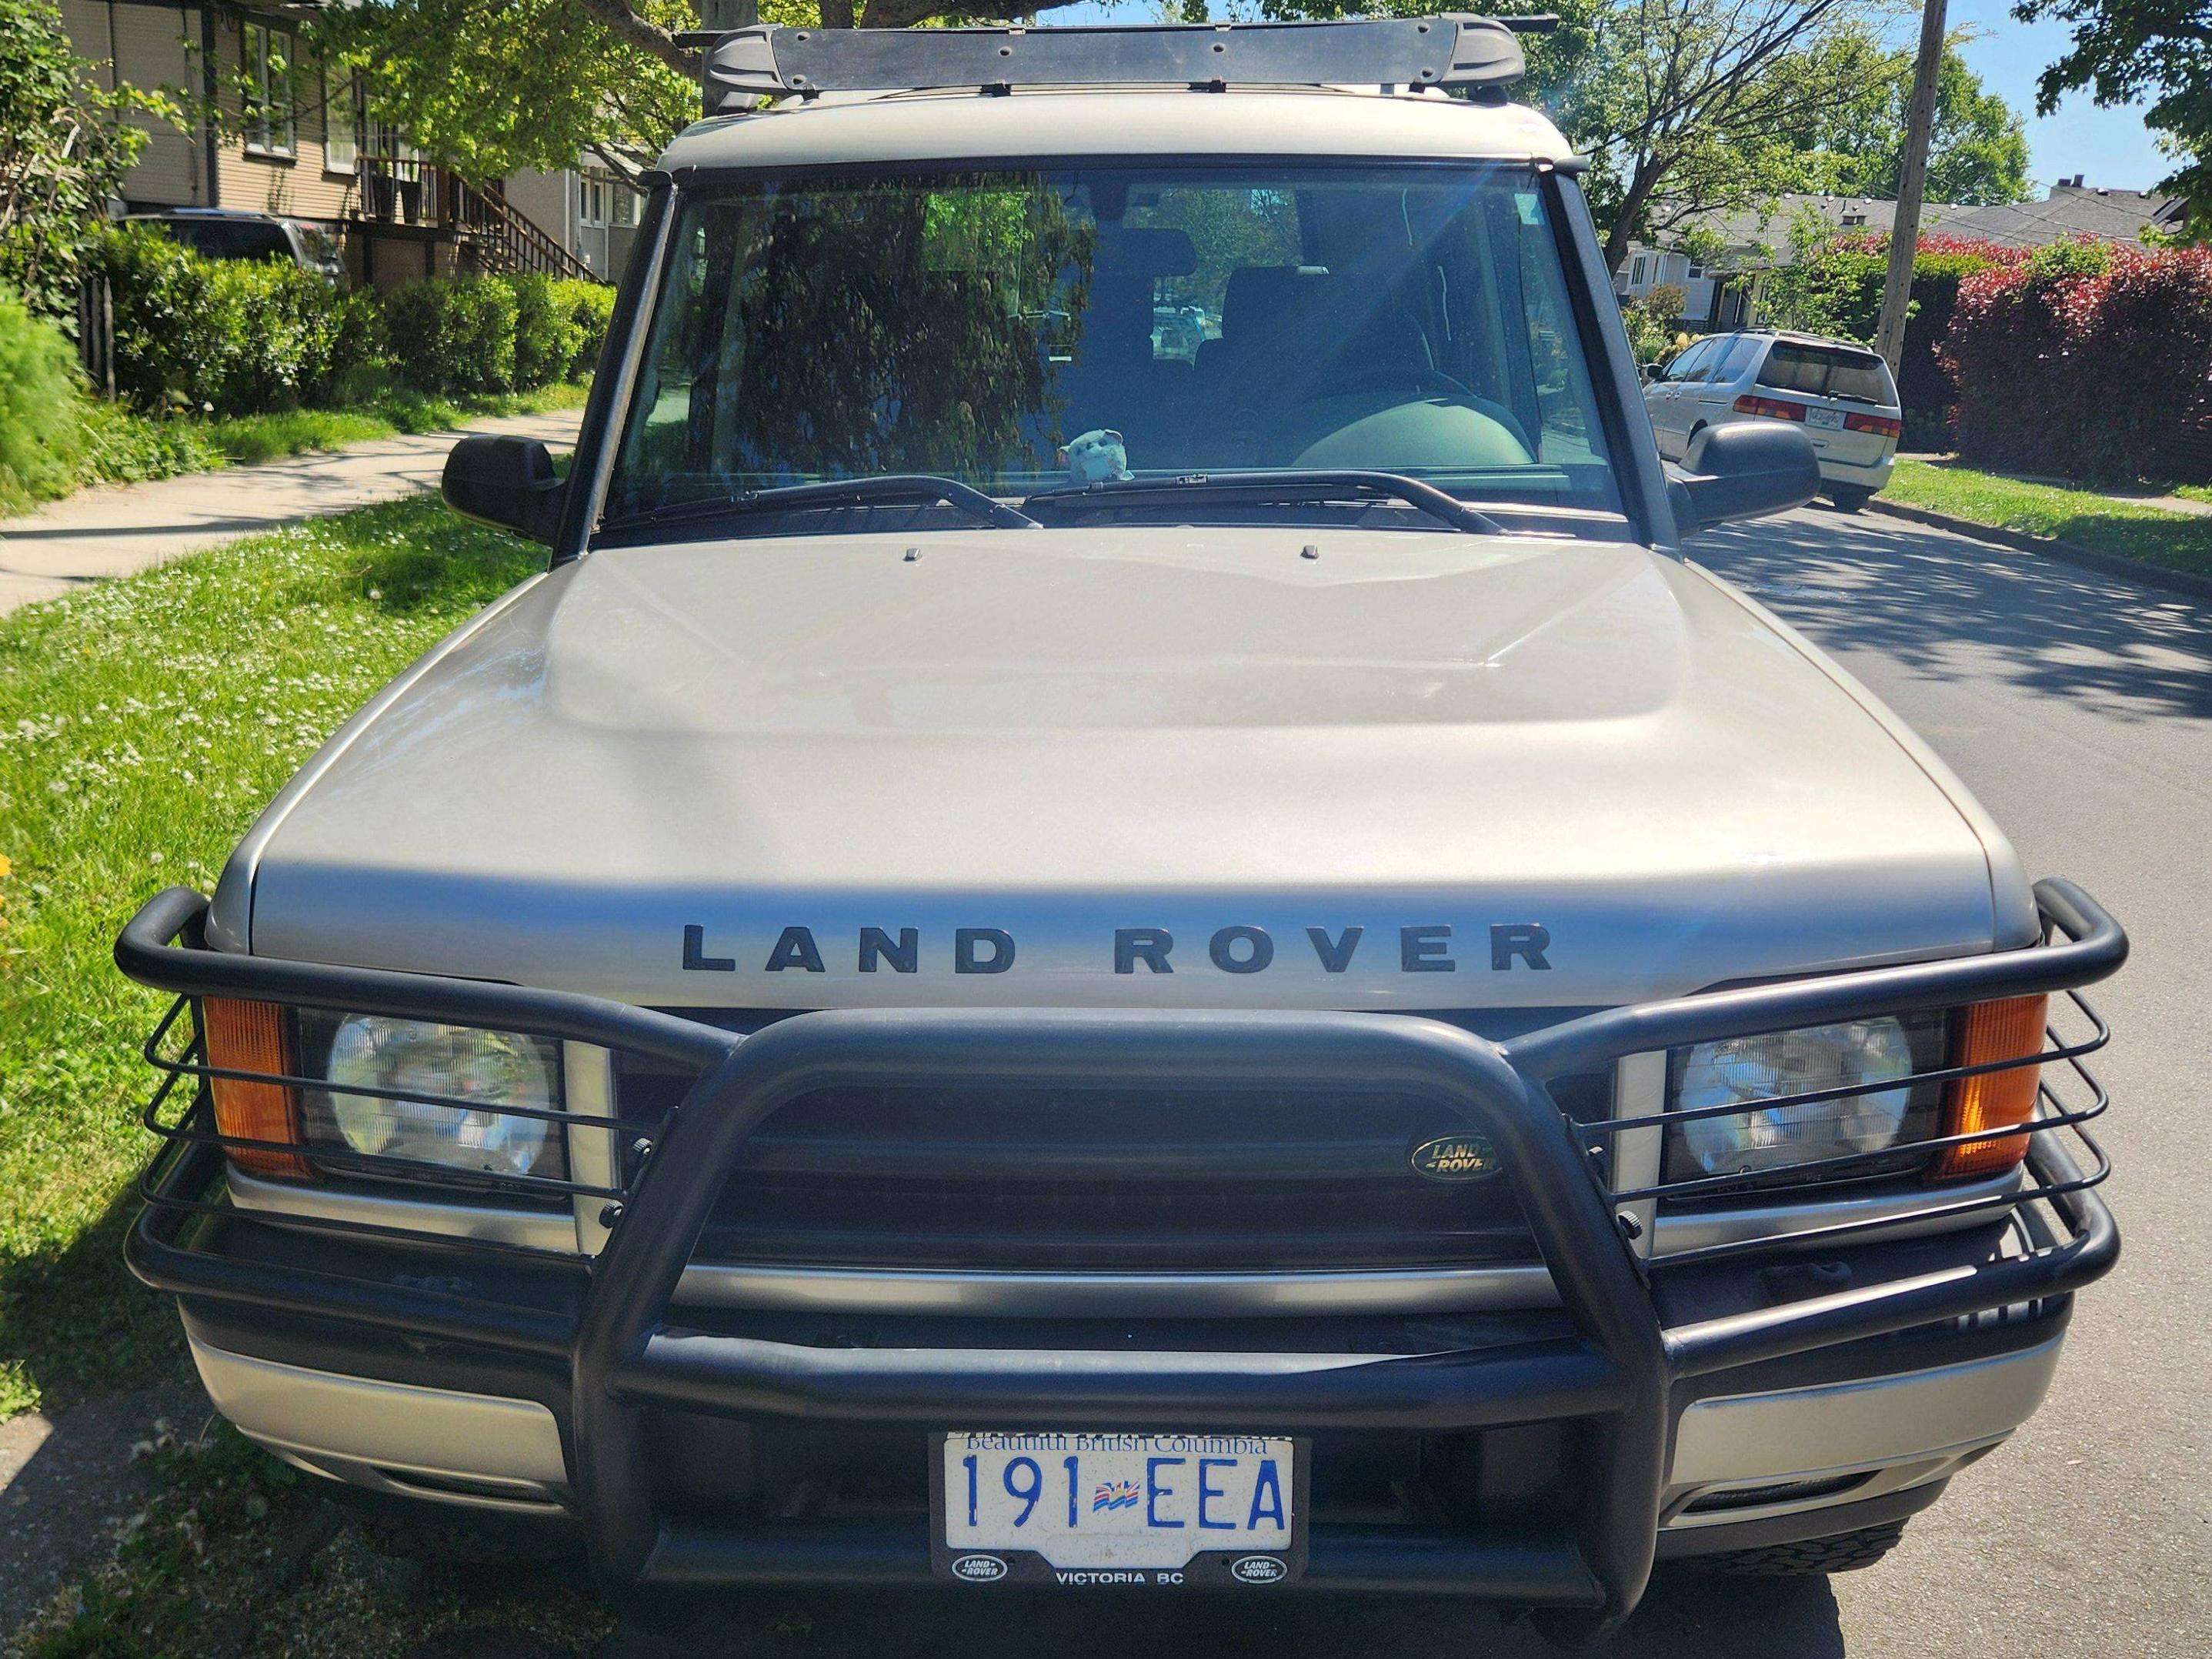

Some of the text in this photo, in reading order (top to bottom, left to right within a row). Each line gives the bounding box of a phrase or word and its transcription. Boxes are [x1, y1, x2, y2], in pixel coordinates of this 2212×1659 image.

[683, 924, 1553, 974] LAND ROVER
[1154, 1436, 1268, 1454] Columbia
[963, 1454, 1285, 1530] 191 EEA
[1056, 1572, 1184, 1585] VICTORIA BC
